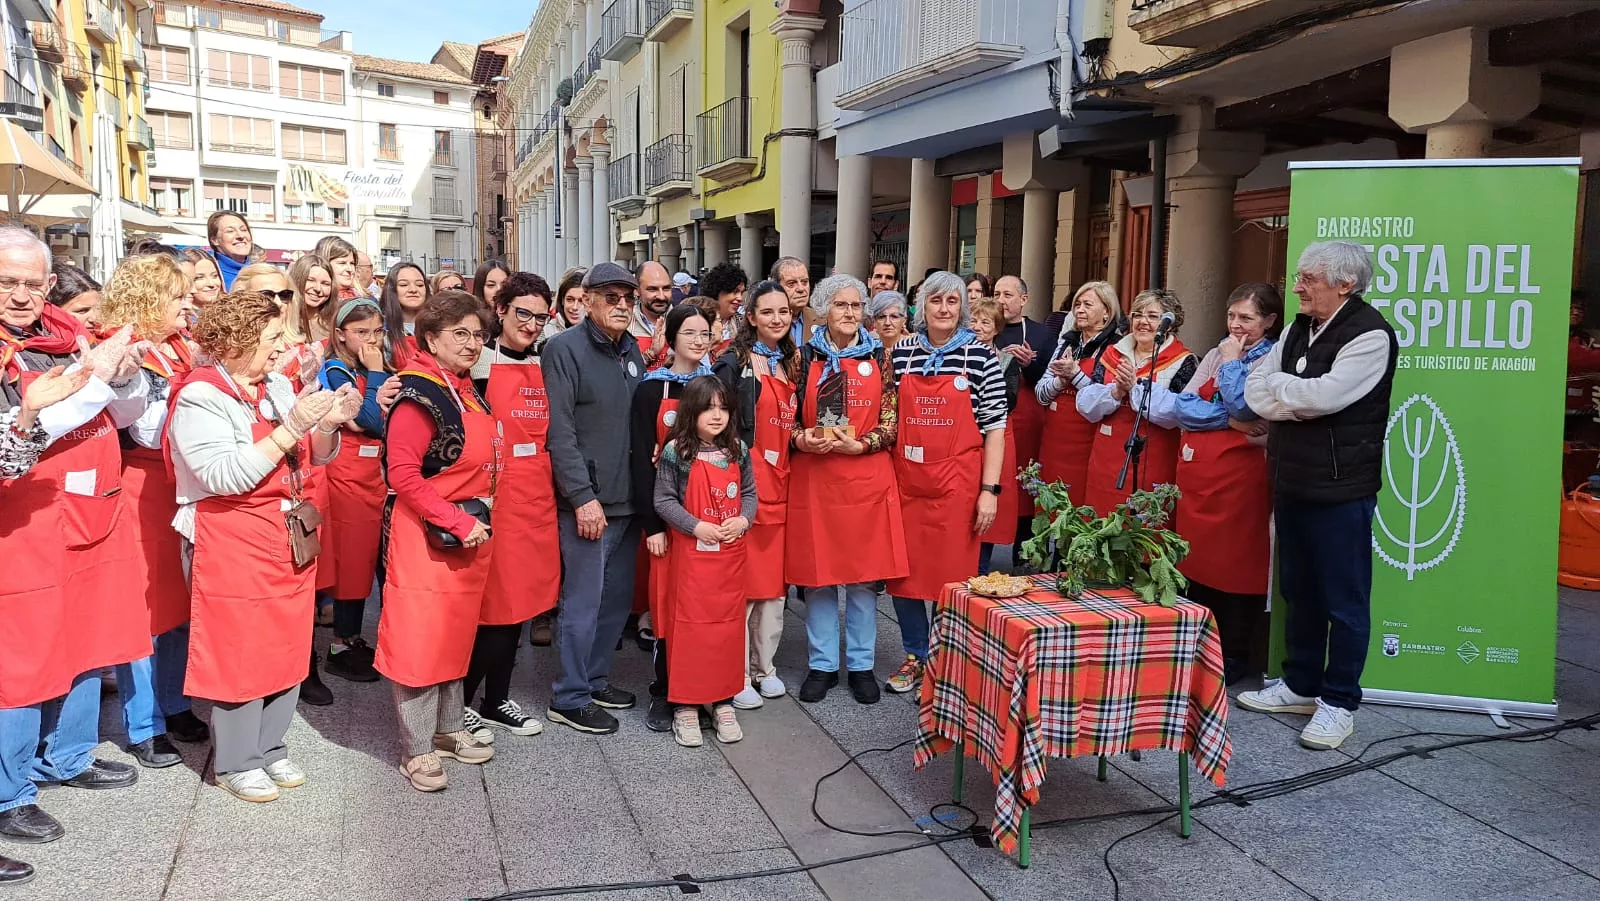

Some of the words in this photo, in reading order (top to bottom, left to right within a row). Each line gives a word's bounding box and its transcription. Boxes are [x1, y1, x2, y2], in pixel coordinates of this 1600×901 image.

[343, 170, 381, 185] Fiesta
[383, 173, 404, 186] del
[1316, 216, 1415, 238] BARBASTRO
[1466, 244, 1541, 294] DEL
[1415, 355, 1470, 370] TURÍSTICO
[1474, 357, 1488, 370] DE
[1491, 355, 1536, 371] ARAGÓN
[519, 387, 547, 396] FIEST
[525, 399, 546, 408] DEL
[915, 396, 947, 405] FIESTA
[921, 407, 940, 415] DEL
[905, 416, 954, 426] CRESPILLO
[1402, 643, 1446, 652] BARBASTRO
